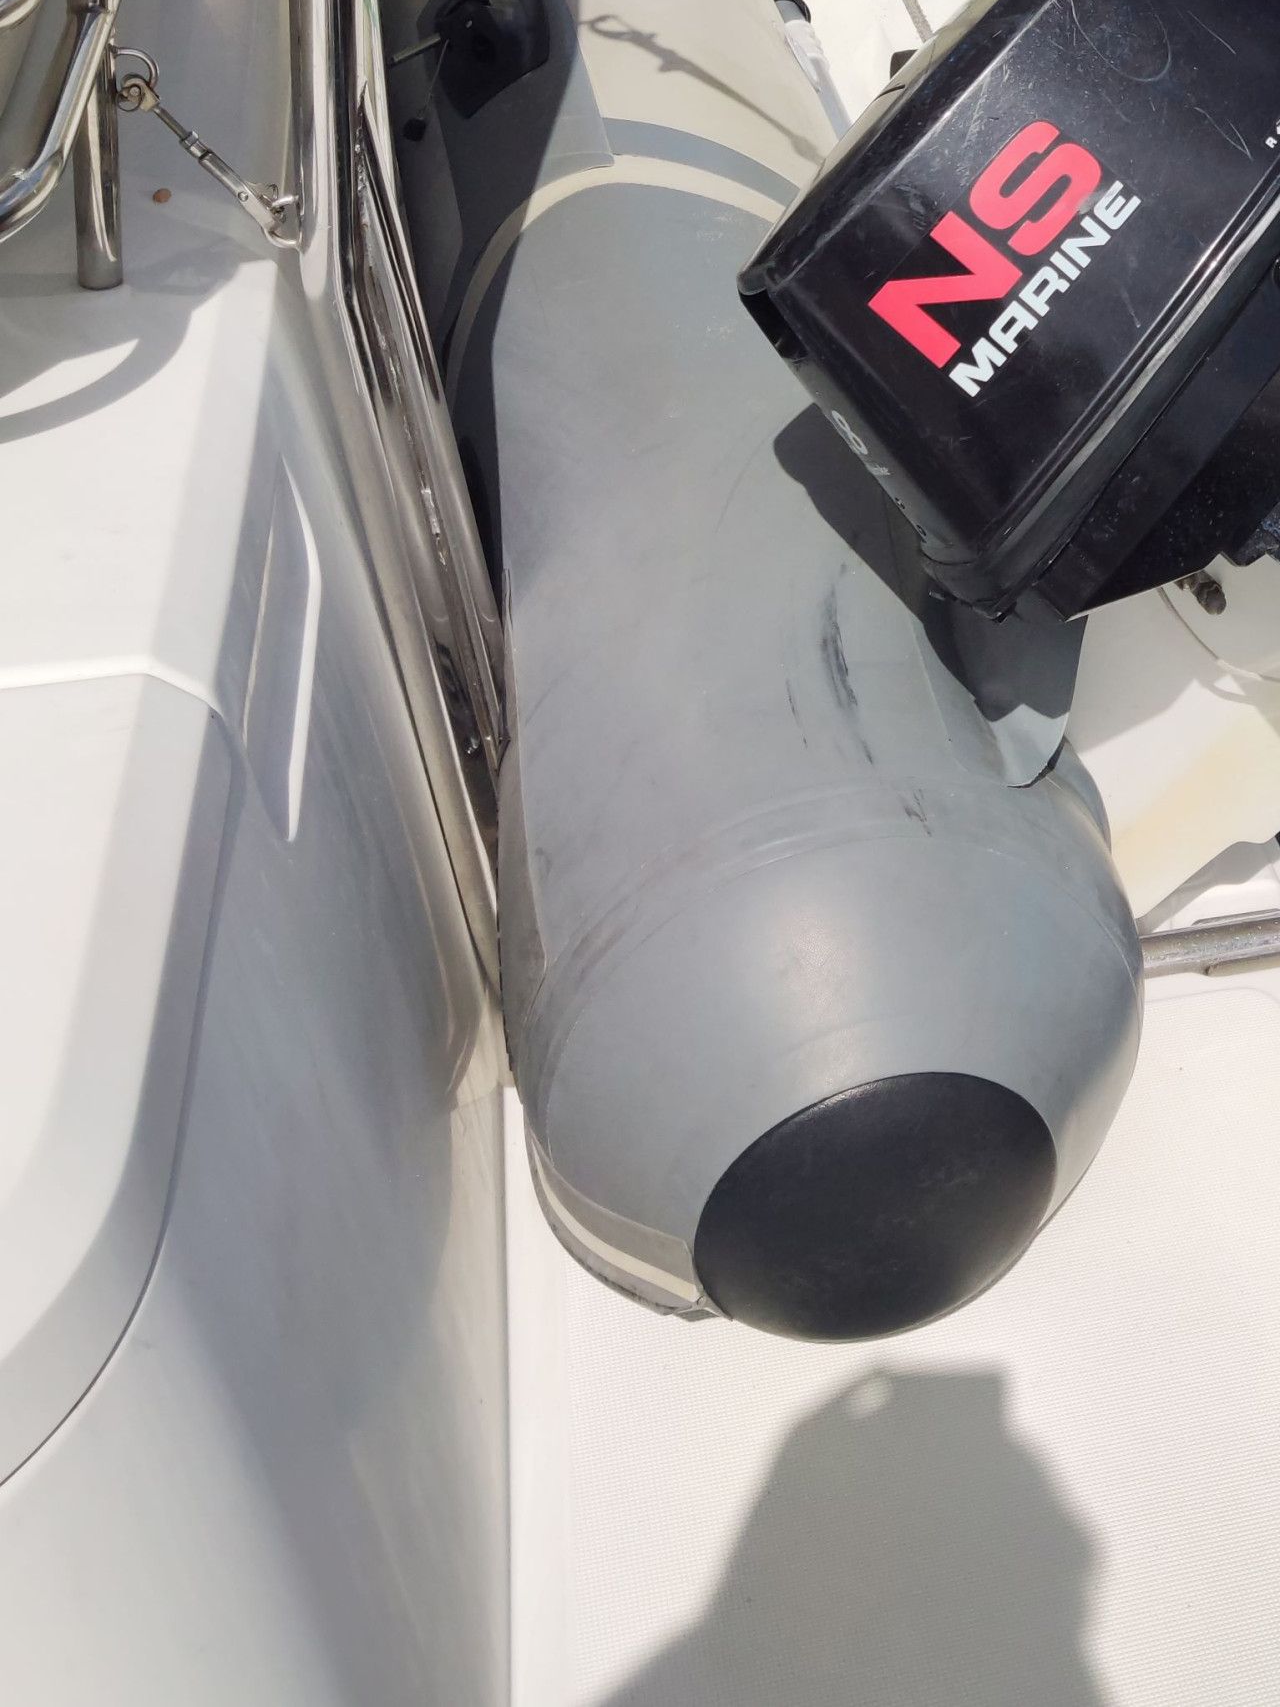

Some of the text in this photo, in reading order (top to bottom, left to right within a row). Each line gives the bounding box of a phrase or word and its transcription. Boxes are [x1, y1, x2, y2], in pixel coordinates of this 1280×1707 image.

[868, 120, 1103, 370] NS
[1264, 136, 1279, 149] R
[948, 179, 1142, 399] MARINE
